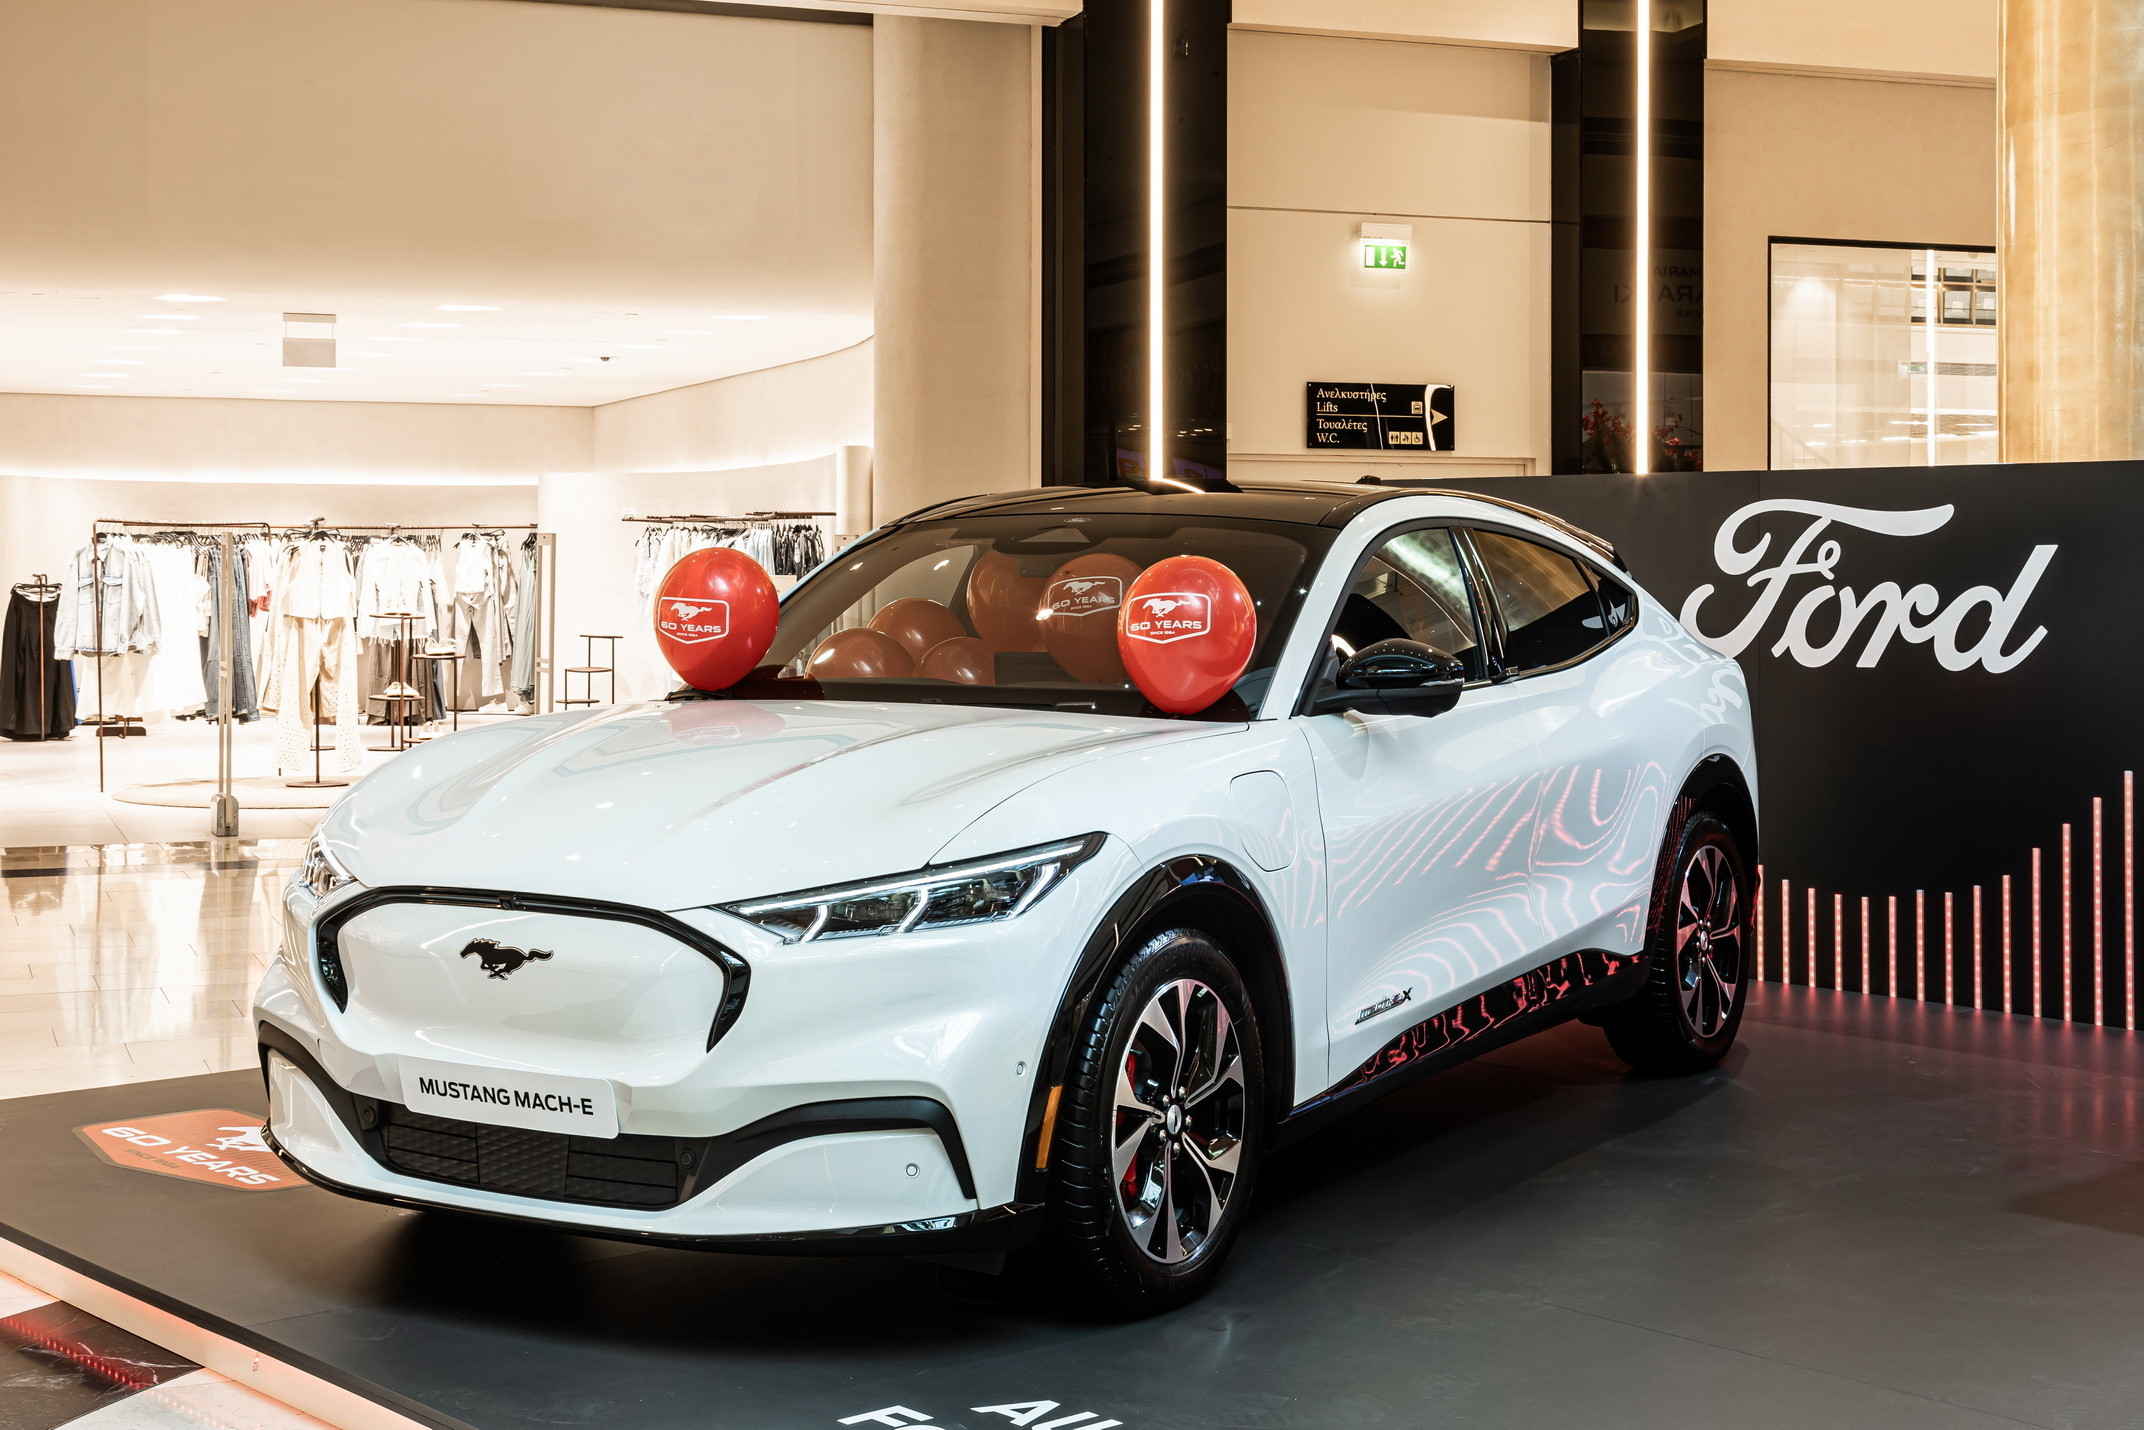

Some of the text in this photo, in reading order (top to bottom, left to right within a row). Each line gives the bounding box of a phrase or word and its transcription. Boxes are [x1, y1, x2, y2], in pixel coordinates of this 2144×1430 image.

[1316, 388, 1387, 403] Ανελκυστήρες
[1316, 402, 1338, 412] Lifts
[1316, 418, 1368, 433] Τουαλέτες
[1316, 433, 1340, 444] W.C.
[1679, 499, 2059, 674] Ford
[1052, 596, 1115, 610] 60 YEARS
[661, 621, 722, 633] 60 YEARS
[1130, 620, 1202, 631] 60 YEARS
[419, 1077, 594, 1115] MUSTANG MACH-E
[102, 1127, 281, 1185] 60 YEARS
